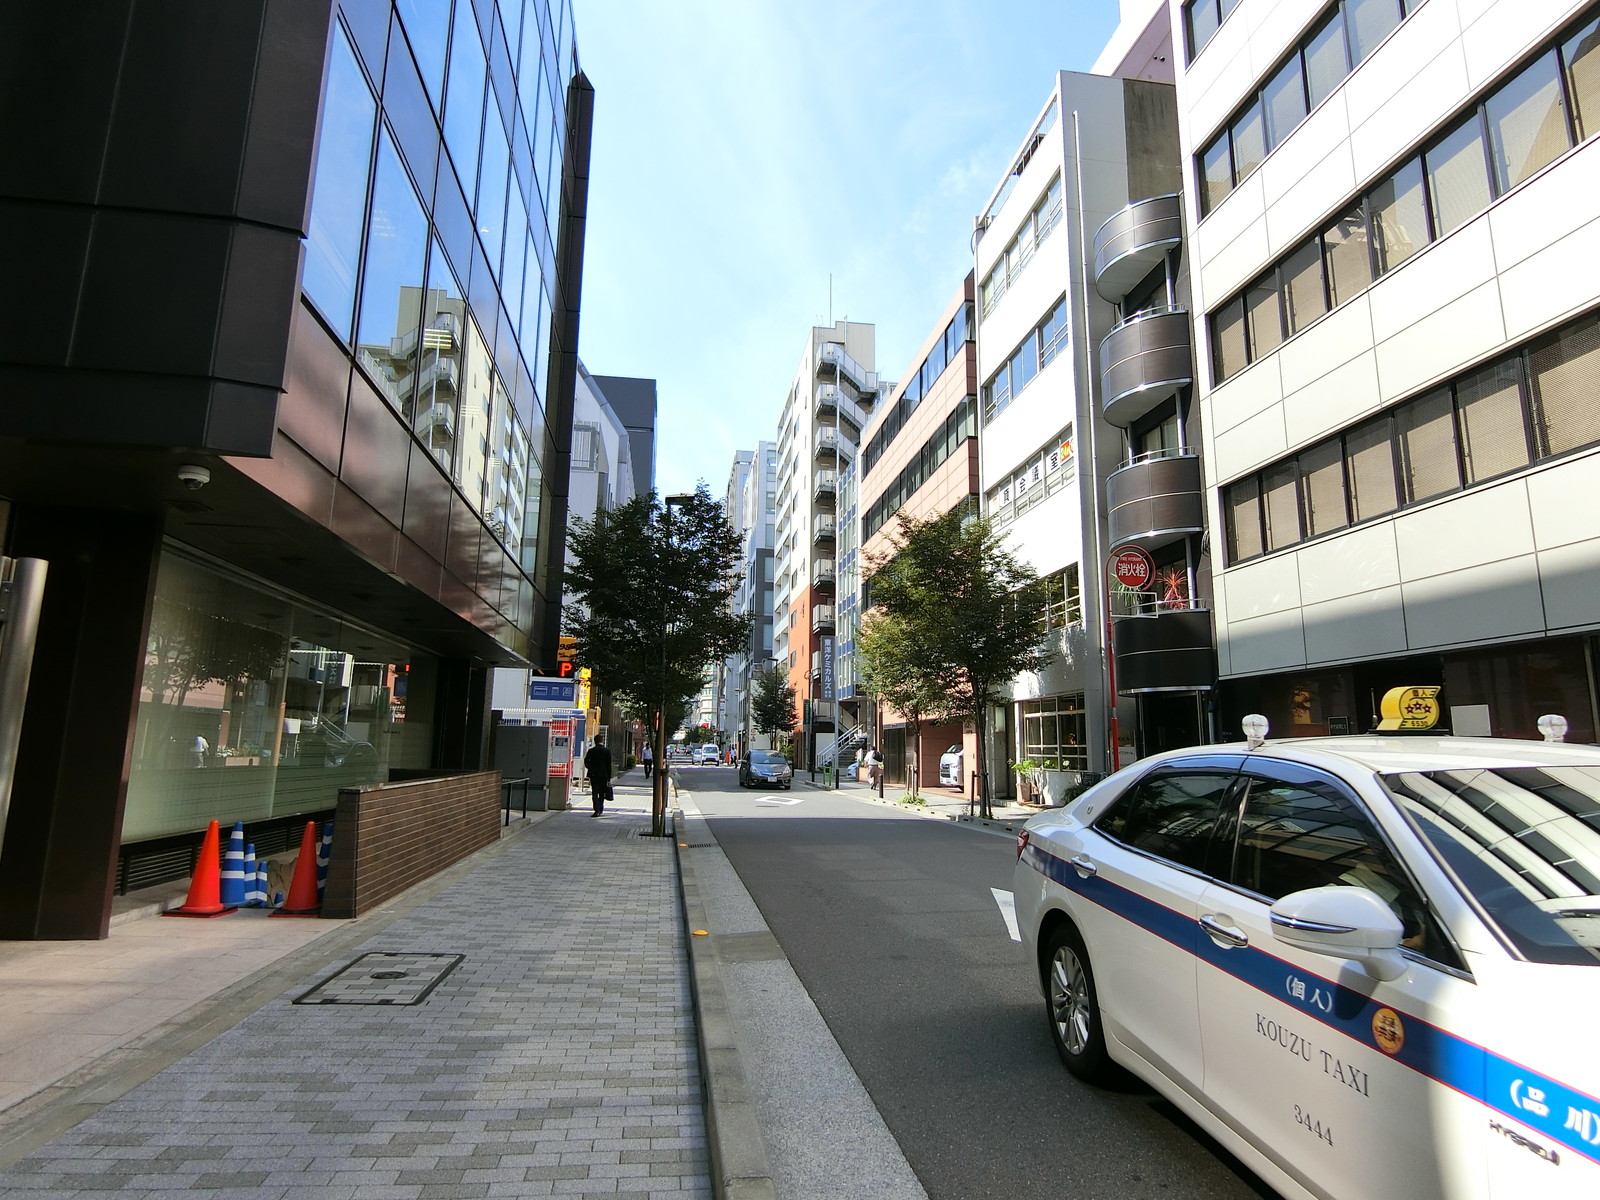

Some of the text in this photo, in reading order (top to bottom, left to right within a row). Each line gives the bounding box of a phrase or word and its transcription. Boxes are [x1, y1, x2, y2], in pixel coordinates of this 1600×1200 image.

[1118, 563, 1146, 577] 消火栓
[561, 662, 573, 677] P
[824, 639, 832, 690] 東洋ケミカルズ
[1285, 974, 1333, 1013] (個人)
[1256, 1012, 1369, 1097] KOUZU TAXI
[1294, 1104, 1334, 1147] 3444
[1509, 1078, 1600, 1146] (品川)
